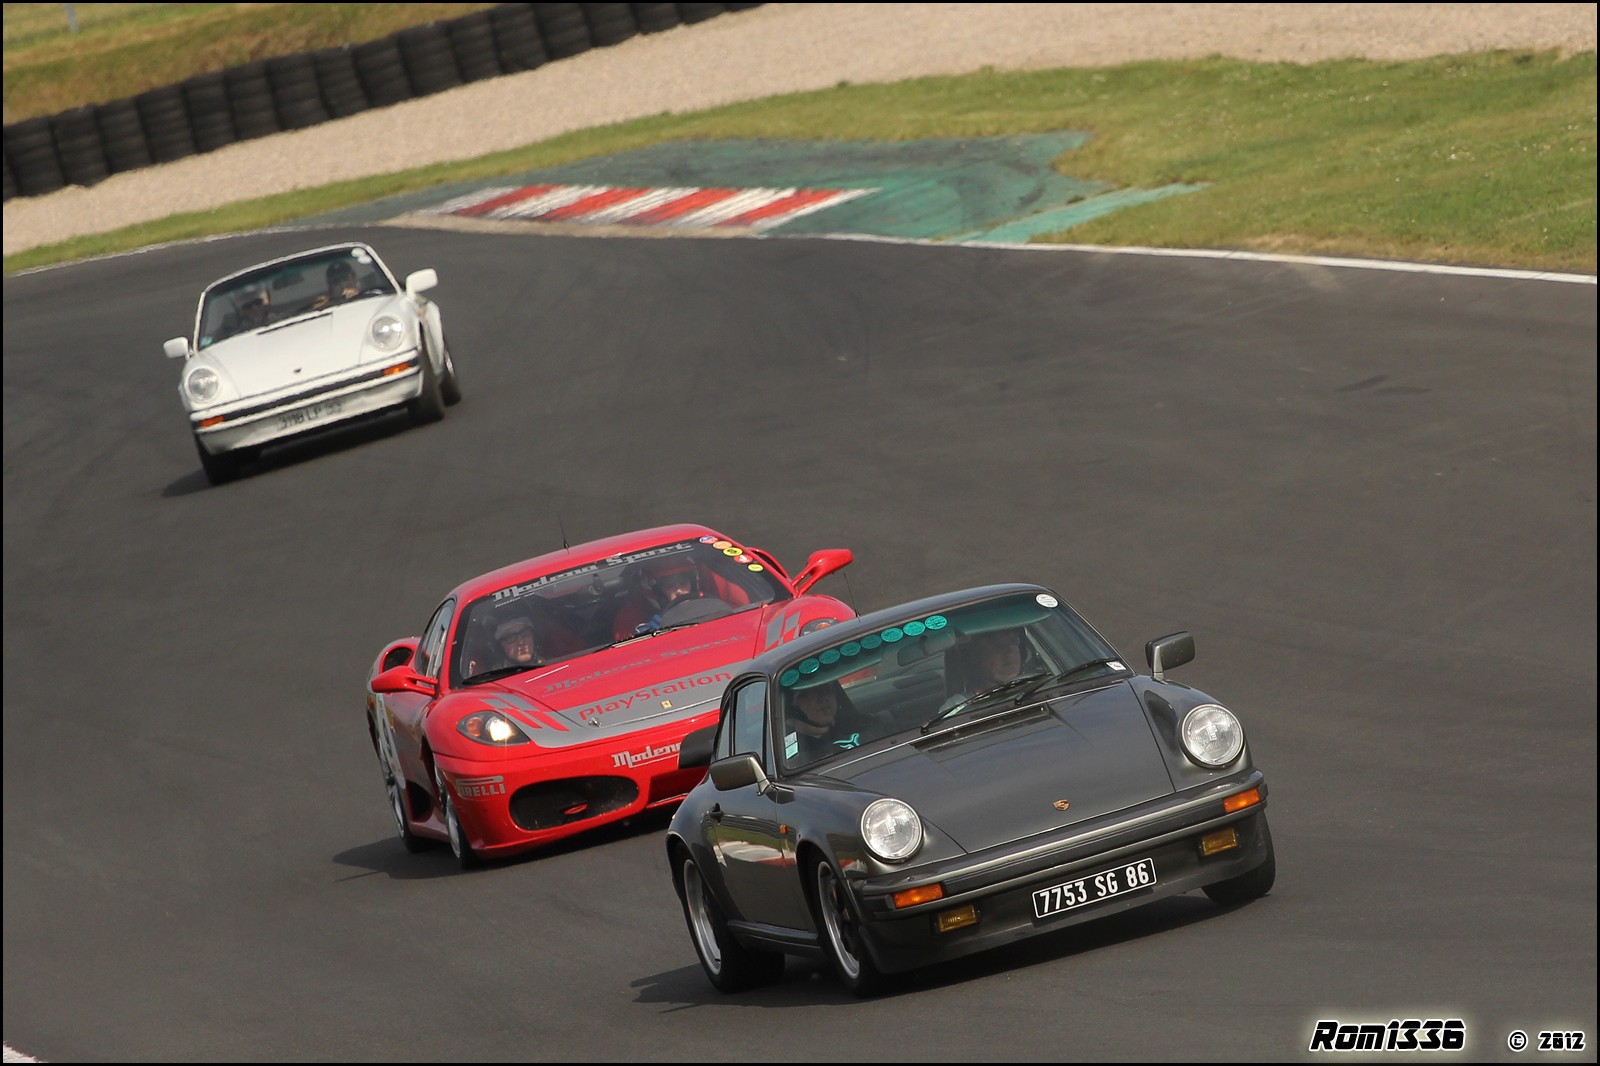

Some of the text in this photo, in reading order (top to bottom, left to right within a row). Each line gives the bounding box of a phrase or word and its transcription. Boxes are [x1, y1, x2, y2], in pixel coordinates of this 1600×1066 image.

[491, 565, 598, 602] Modena
[606, 543, 692, 566] Sport
[579, 671, 732, 721] PlayStation
[456, 775, 506, 799] PIRELLI
[1039, 863, 1149, 913] 7753 SG 86
